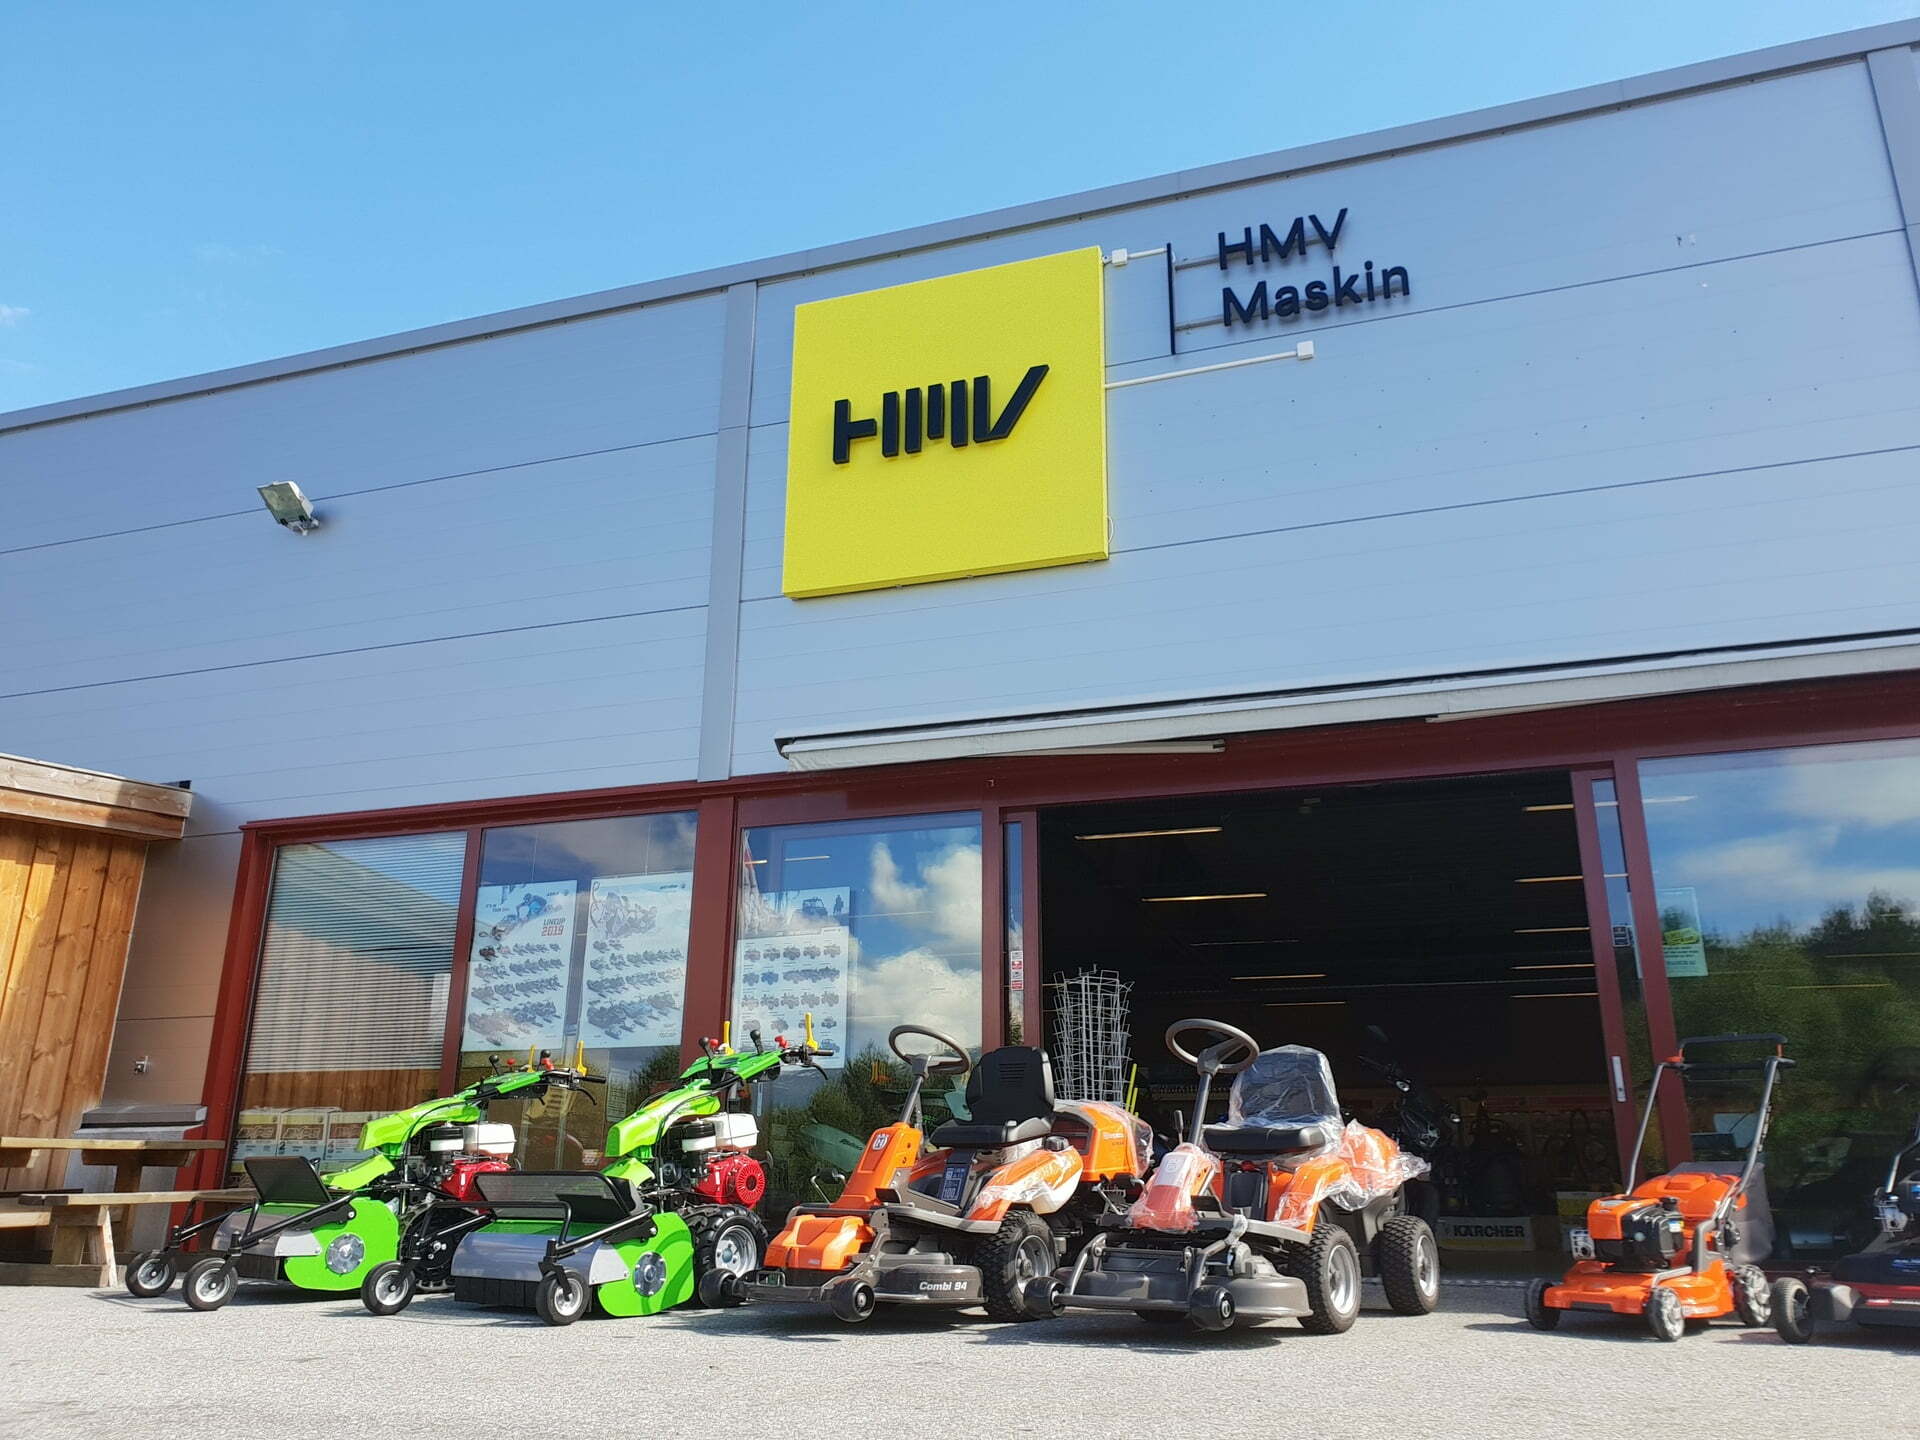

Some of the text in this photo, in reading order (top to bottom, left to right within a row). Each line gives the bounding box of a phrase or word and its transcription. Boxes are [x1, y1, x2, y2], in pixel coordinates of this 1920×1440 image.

[1217, 207, 1349, 271] HMV
[1221, 261, 1411, 328] Maskin
[832, 364, 1050, 465] HMV
[541, 925, 564, 937] 2019
[919, 1281, 968, 1291] Combi 94
